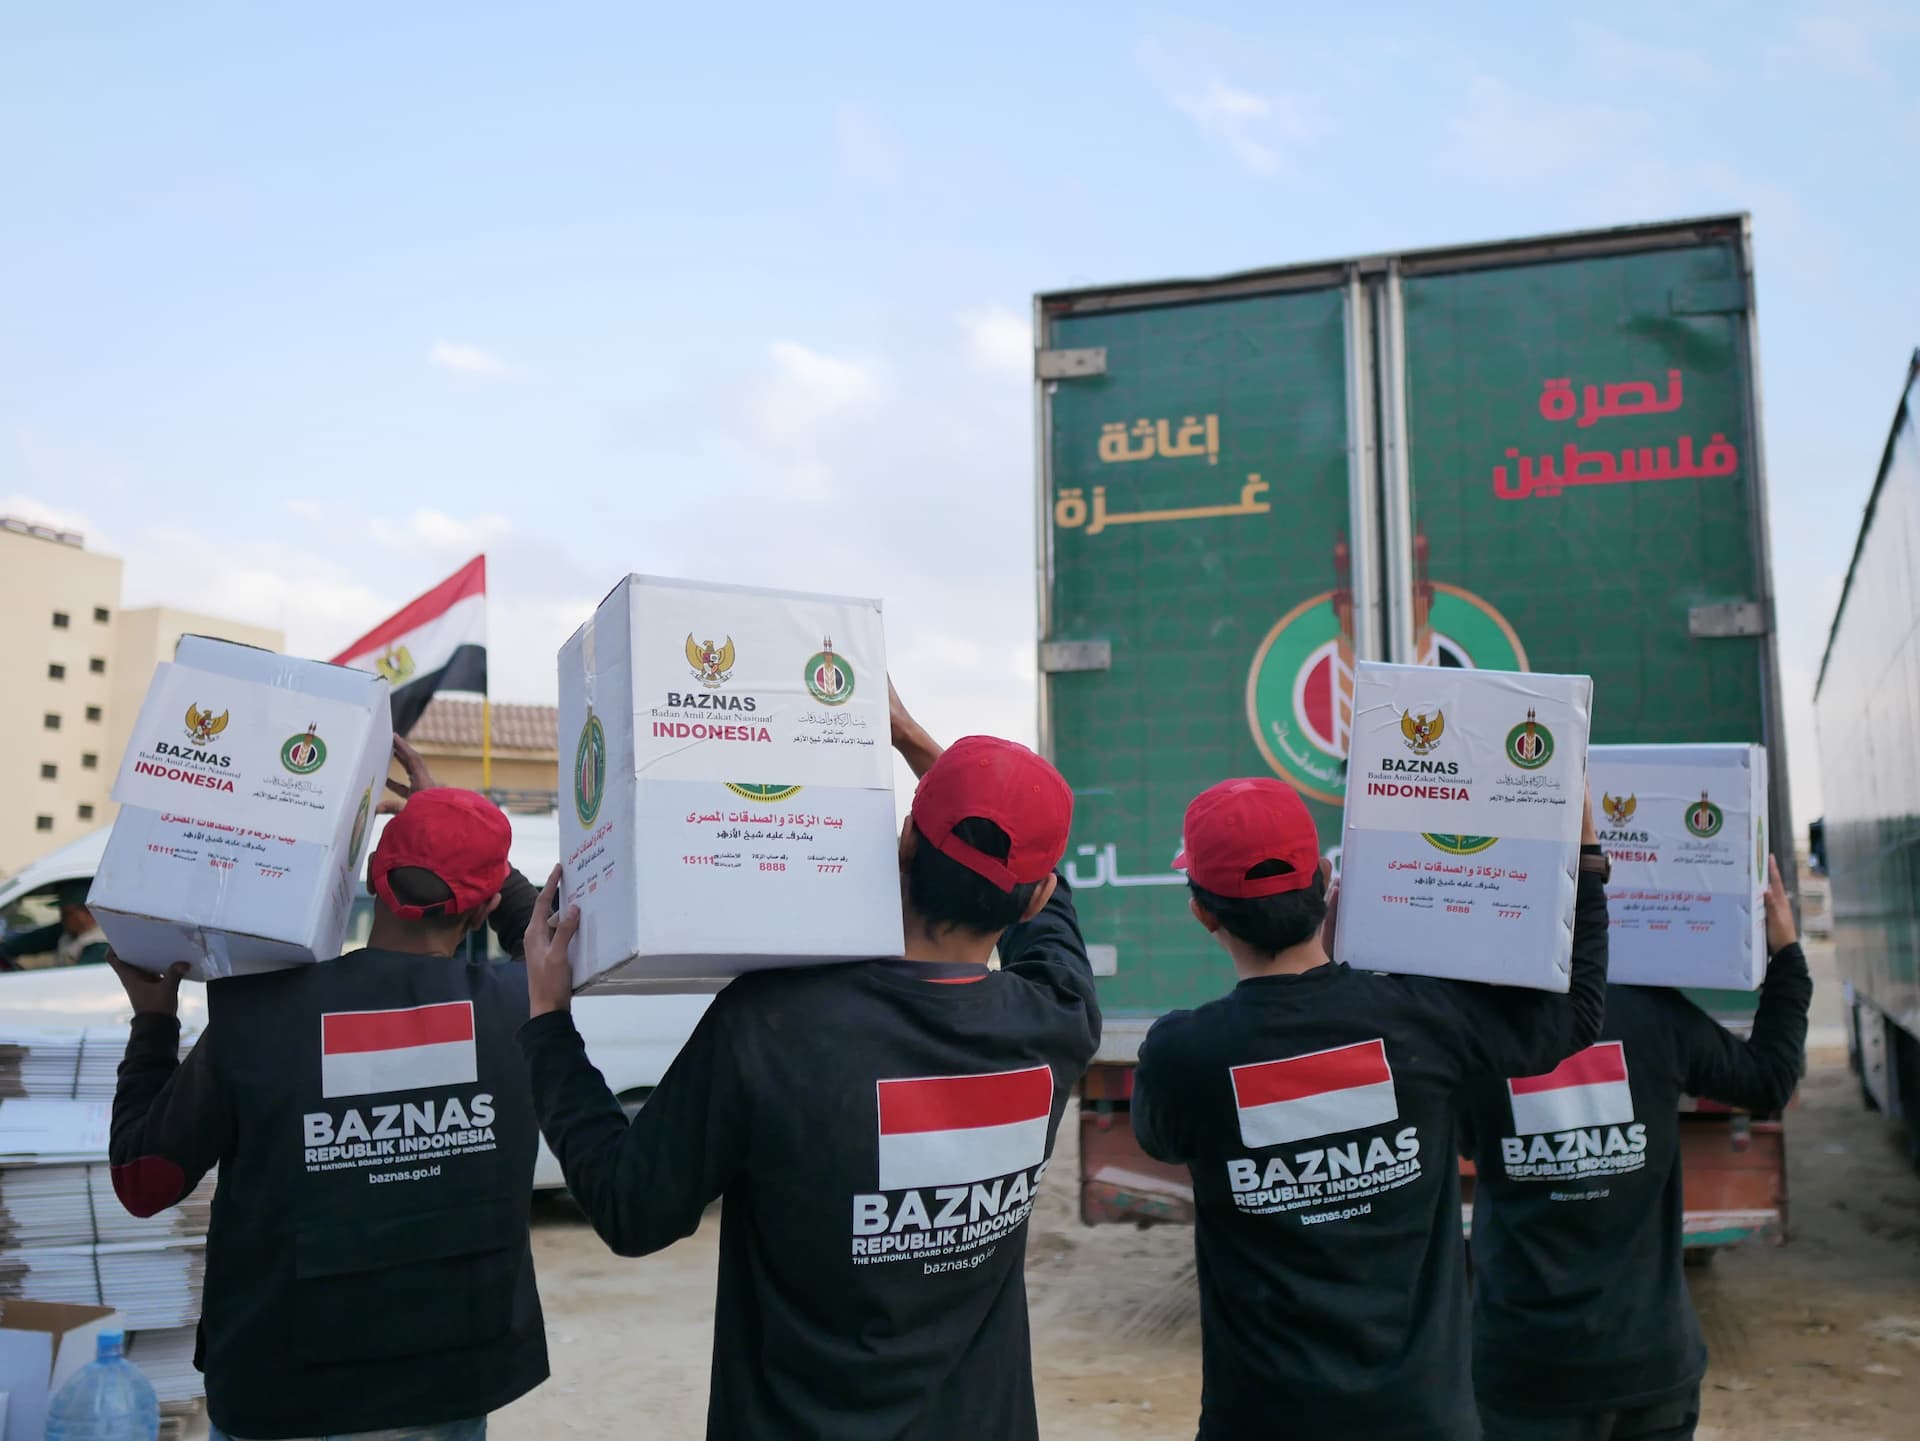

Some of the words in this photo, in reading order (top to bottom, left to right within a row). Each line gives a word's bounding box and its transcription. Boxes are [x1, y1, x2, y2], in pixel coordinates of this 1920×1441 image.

[1539, 368, 1683, 429] نصرة
[1098, 414, 1219, 465] إغاثة
[1493, 432, 1738, 500] فلسطين
[668, 692, 756, 712] BAZNAS
[652, 709, 680, 718] Badan
[683, 711, 704, 720] Amil
[706, 712, 731, 721] Zakat
[653, 721, 772, 742] INDONESIA
[155, 742, 231, 768] BAZNAS
[1382, 758, 1459, 775] BAZNAS
[135, 761, 234, 793] INDONESIA
[1368, 772, 1391, 780] Badan
[1394, 773, 1412, 781] Amil
[1414, 774, 1435, 782] Zakat
[1438, 776, 1472, 785] Nasional
[1368, 783, 1470, 801] INDONESIA
[728, 811, 785, 827] والصدقات
[788, 813, 819, 828] الزكاة
[823, 815, 843, 829] بيت
[744, 830, 763, 841] شيخ
[766, 831, 784, 840] عليه
[786, 831, 813, 842] يشرف
[1596, 831, 1648, 842] AZNAS
[147, 843, 175, 856] 15111
[682, 856, 715, 865] 15111
[760, 862, 786, 871] 8888
[817, 864, 842, 873] 7777
[260, 868, 283, 878] 7777
[1477, 866, 1505, 879] الزكاة
[1509, 869, 1528, 882] بيت
[1382, 895, 1409, 905] 15111
[1446, 904, 1470, 914] 8888
[1498, 910, 1522, 919] 7777
[303, 1093, 496, 1147] BAZNAS
[305, 1141, 395, 1163] REPUBLIK
[400, 1127, 495, 1153] INDONESIA
[1501, 1123, 1647, 1164] BAZNAS
[306, 1165, 320, 1173] THE
[321, 1161, 357, 1171] NATIONAL
[358, 1158, 382, 1167] BOARD
[384, 1157, 394, 1165] OF
[395, 1154, 417, 1163] ZAKAT
[419, 1150, 450, 1160] REPUBLIC
[452, 1148, 461, 1156] OF
[1226, 1126, 1421, 1193] BAZNAS
[369, 1165, 441, 1184] baznas.go.id
[1504, 1161, 1577, 1177] REPUBLIK
[1233, 1183, 1323, 1207] REPUBLIK
[1326, 1158, 1421, 1195] INDONESIA
[1287, 1200, 1311, 1211] BOARD
[1312, 1198, 1322, 1206] OF
[1380, 1184, 1390, 1192] OF
[1301, 1203, 1372, 1226] baznas.go.id
[852, 1228, 956, 1256] REPUBLIK
[852, 1257, 869, 1265] THE
[871, 1254, 911, 1264] NATIONAL
[913, 1249, 940, 1259] BOARD
[955, 1242, 978, 1254] ZAKAT
